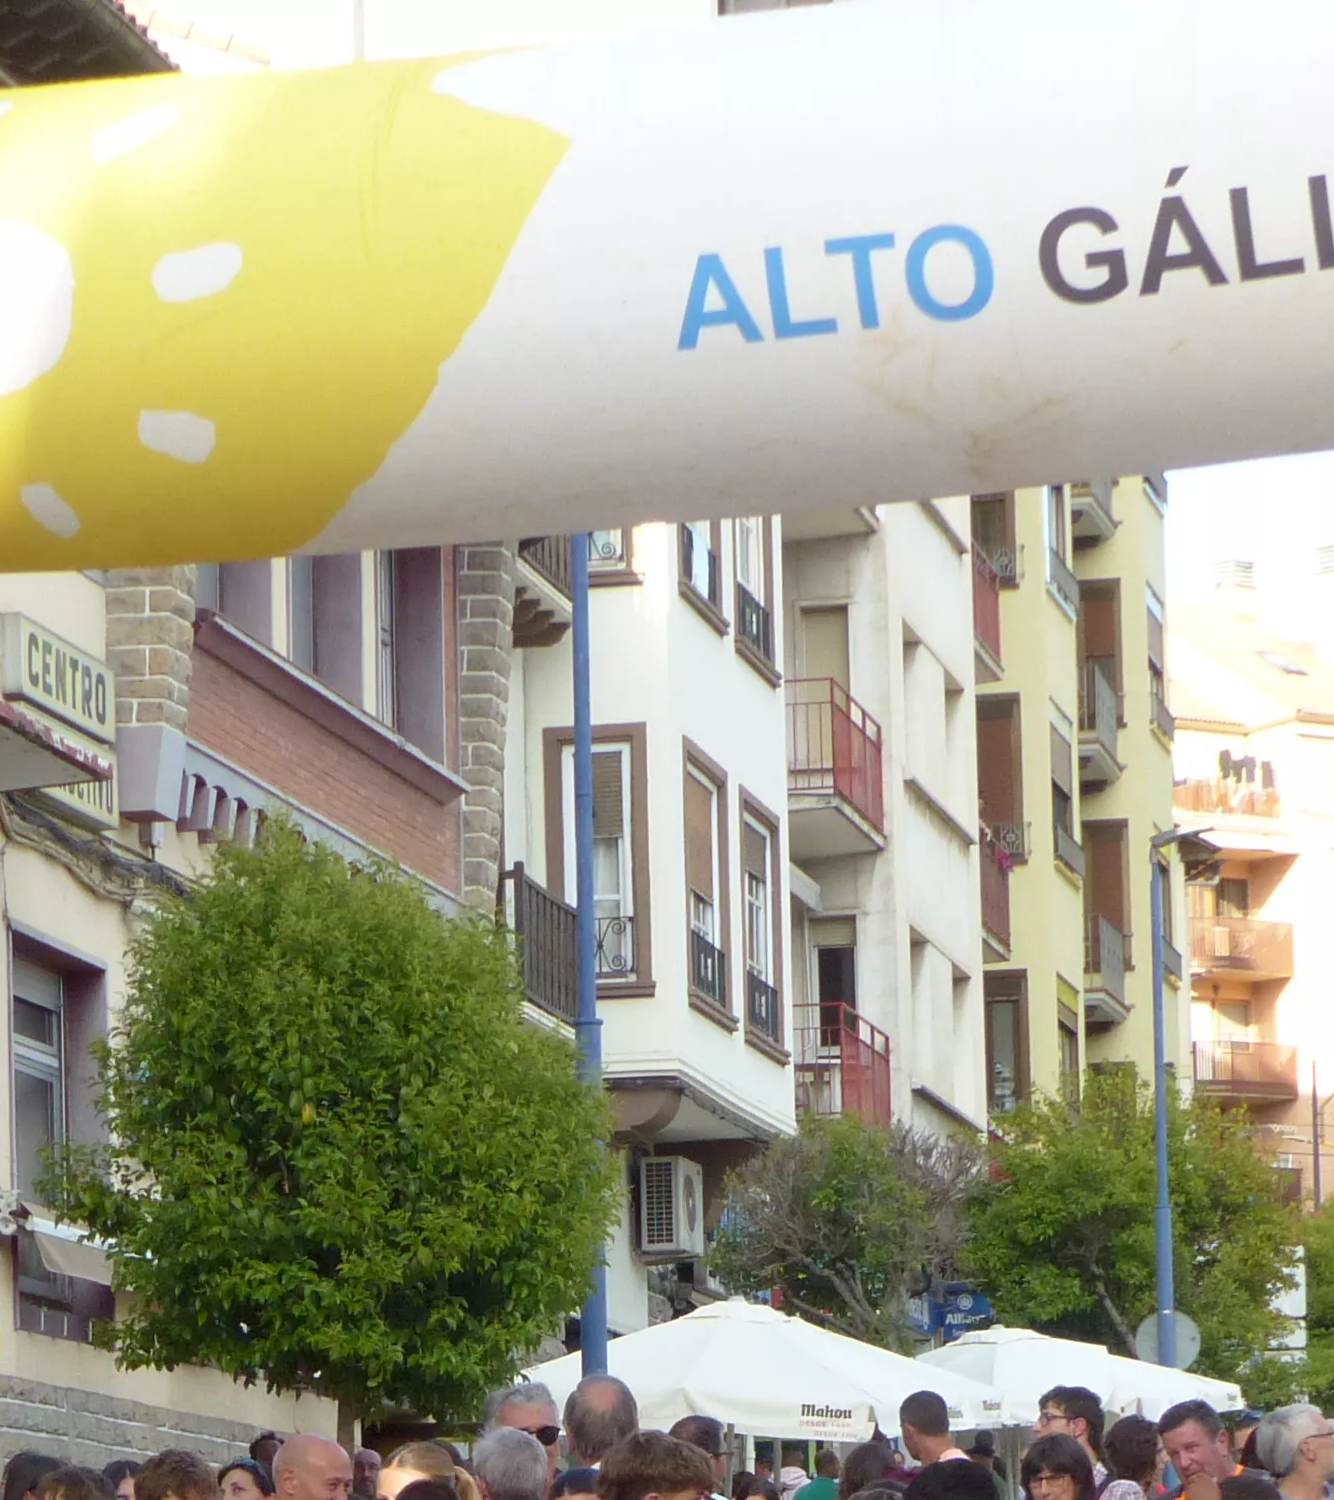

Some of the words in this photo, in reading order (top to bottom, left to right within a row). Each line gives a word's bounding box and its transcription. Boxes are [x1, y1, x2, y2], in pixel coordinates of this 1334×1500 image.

[677, 223, 994, 351] ALTO
[28, 632, 106, 726] CENTRO
[801, 1404, 852, 1419] Mahou
